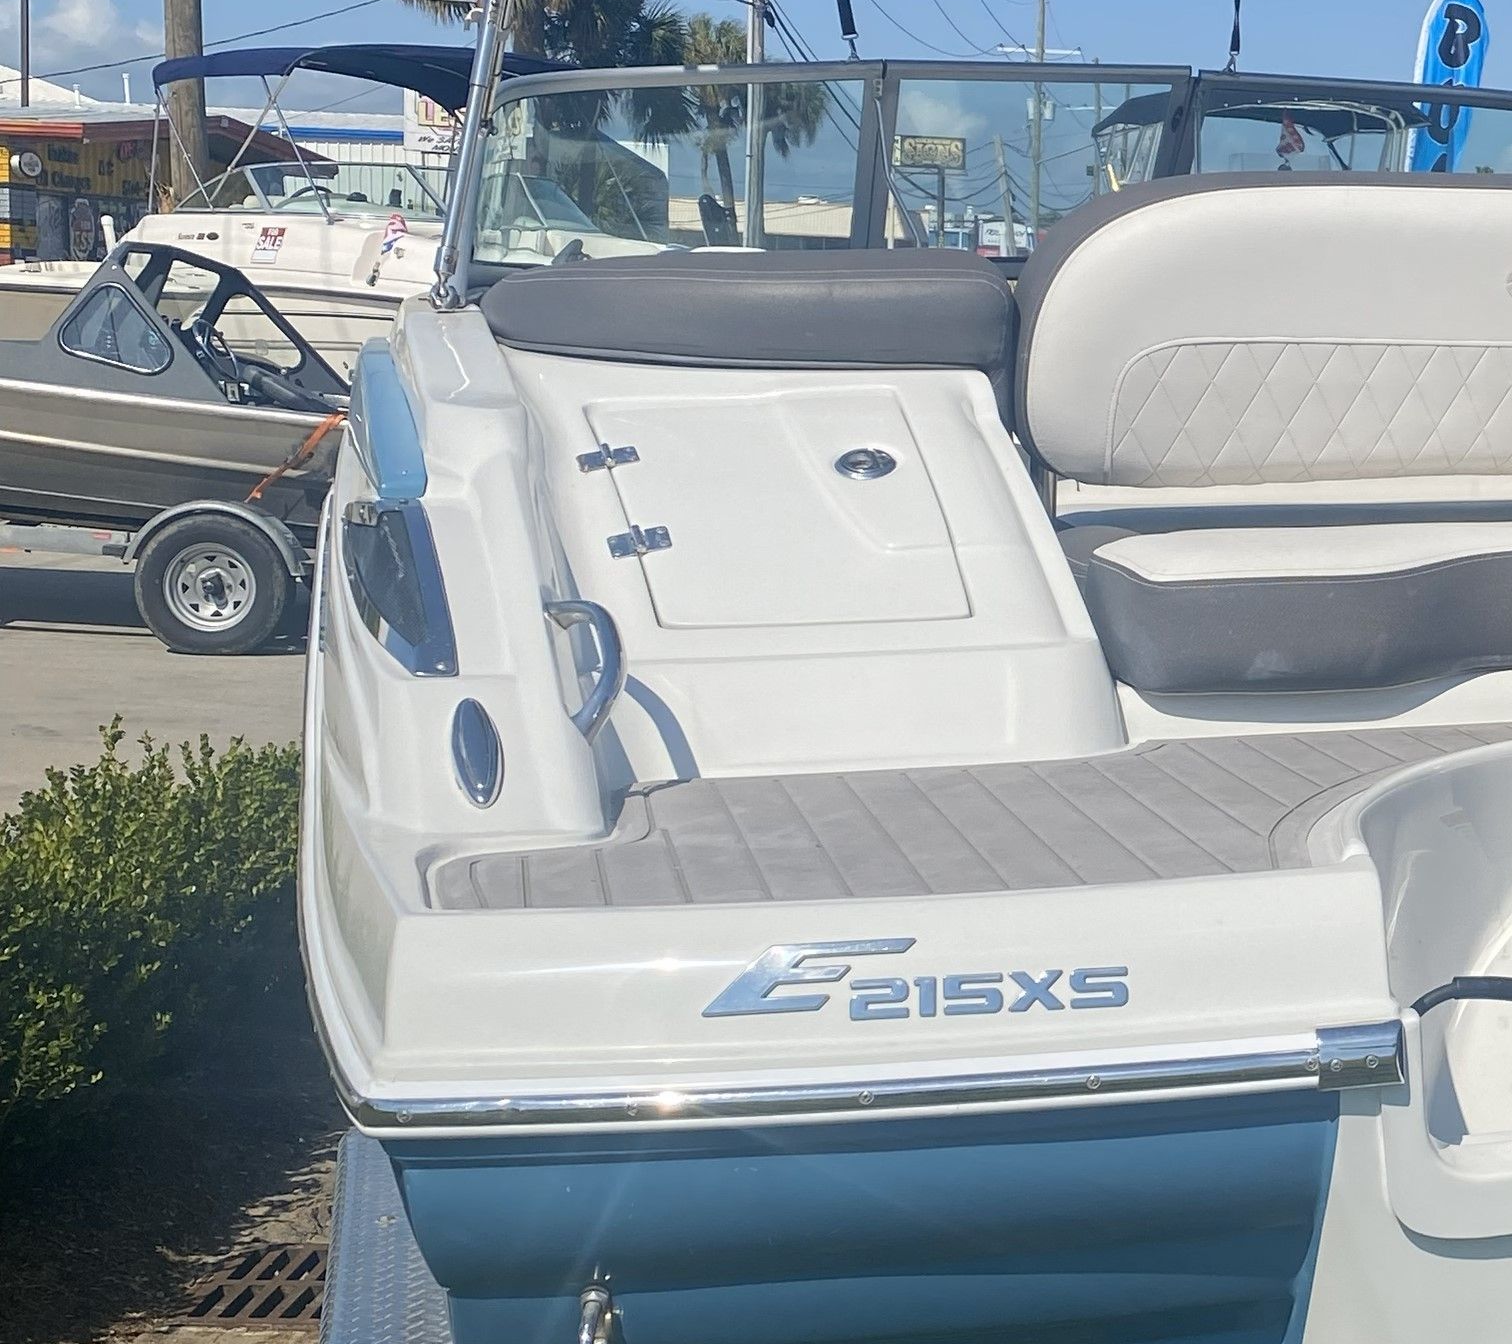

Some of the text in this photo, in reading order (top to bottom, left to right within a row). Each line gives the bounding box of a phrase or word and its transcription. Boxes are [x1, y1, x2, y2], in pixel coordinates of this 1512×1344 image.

[902, 138, 963, 167] SIGNS
[256, 236, 283, 250] SALE
[847, 965, 1130, 1022] 215XS
